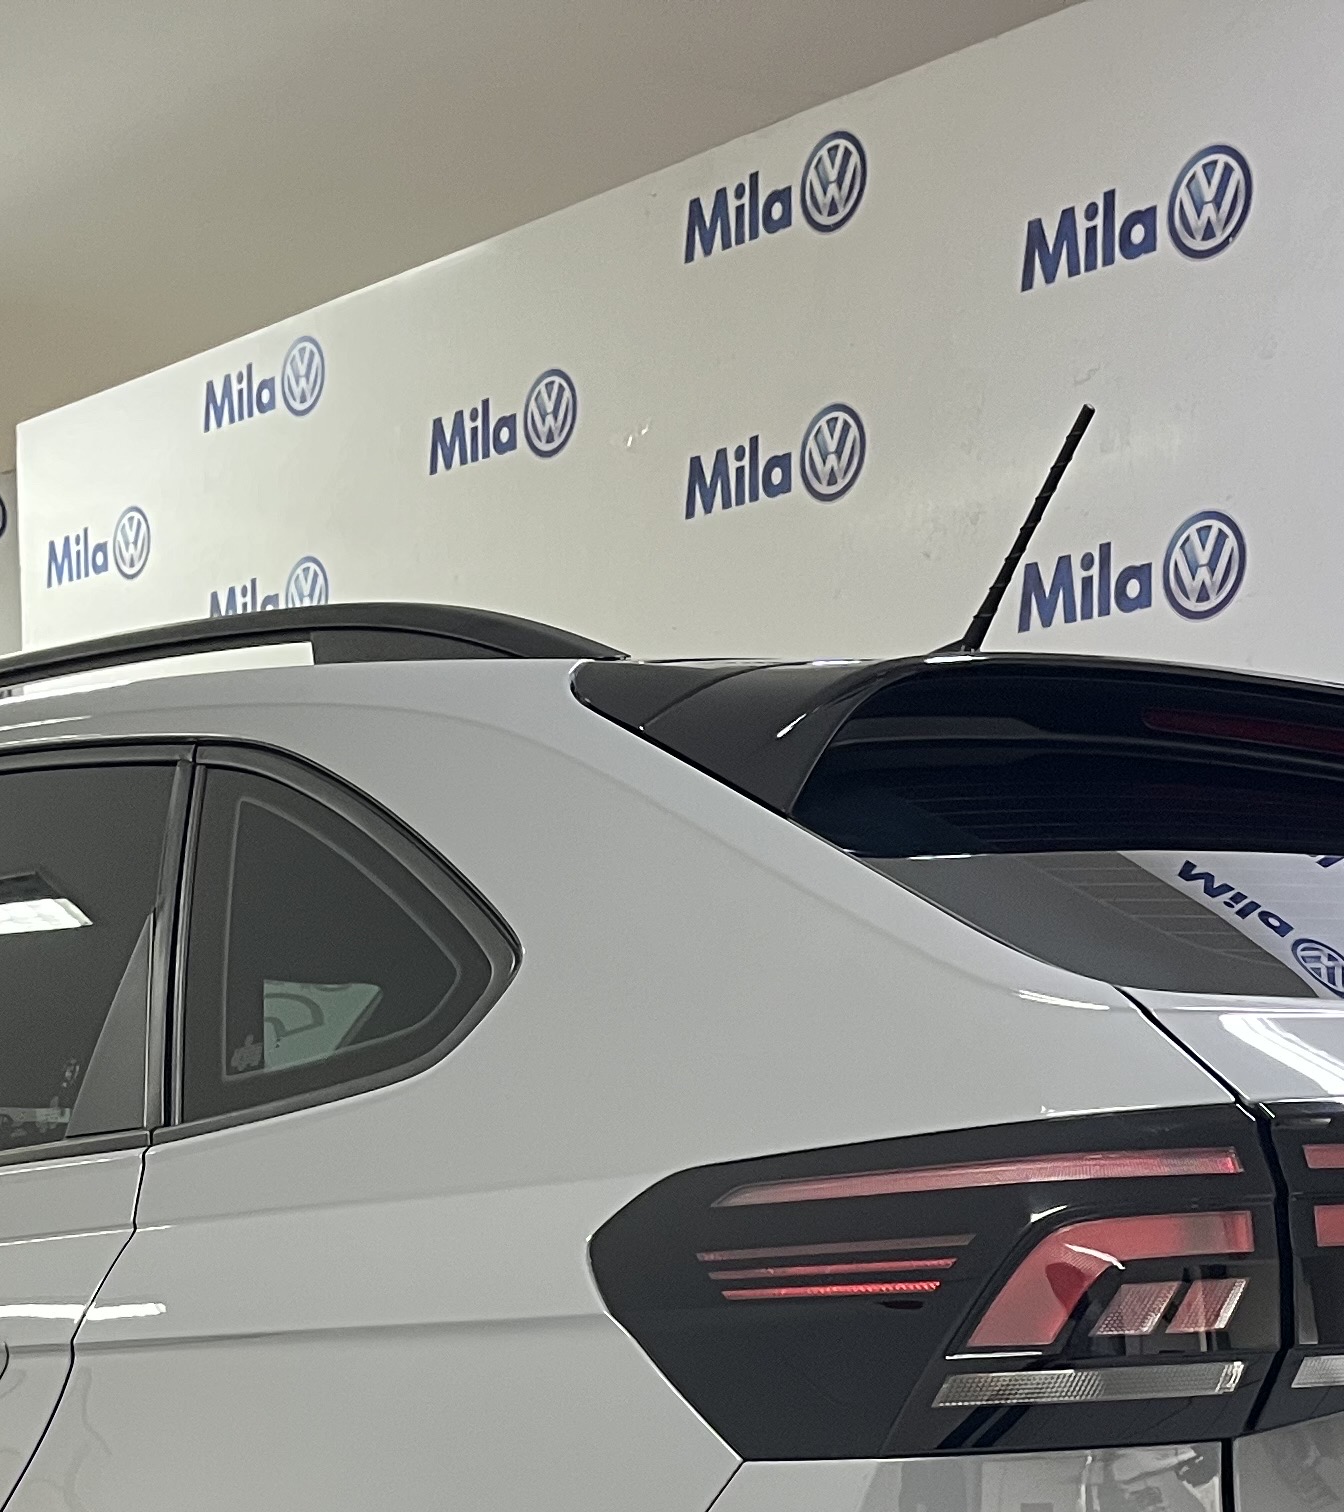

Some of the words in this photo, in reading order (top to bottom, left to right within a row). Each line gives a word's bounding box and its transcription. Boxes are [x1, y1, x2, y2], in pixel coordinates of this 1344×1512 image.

[684, 171, 792, 264] Mila
[1020, 188, 1157, 292] Mila
[203, 362, 276, 433] Mila
[429, 398, 518, 476] Mila
[684, 434, 792, 520] Mila
[47, 527, 108, 588] Mila
[1017, 542, 1153, 633] Mila
